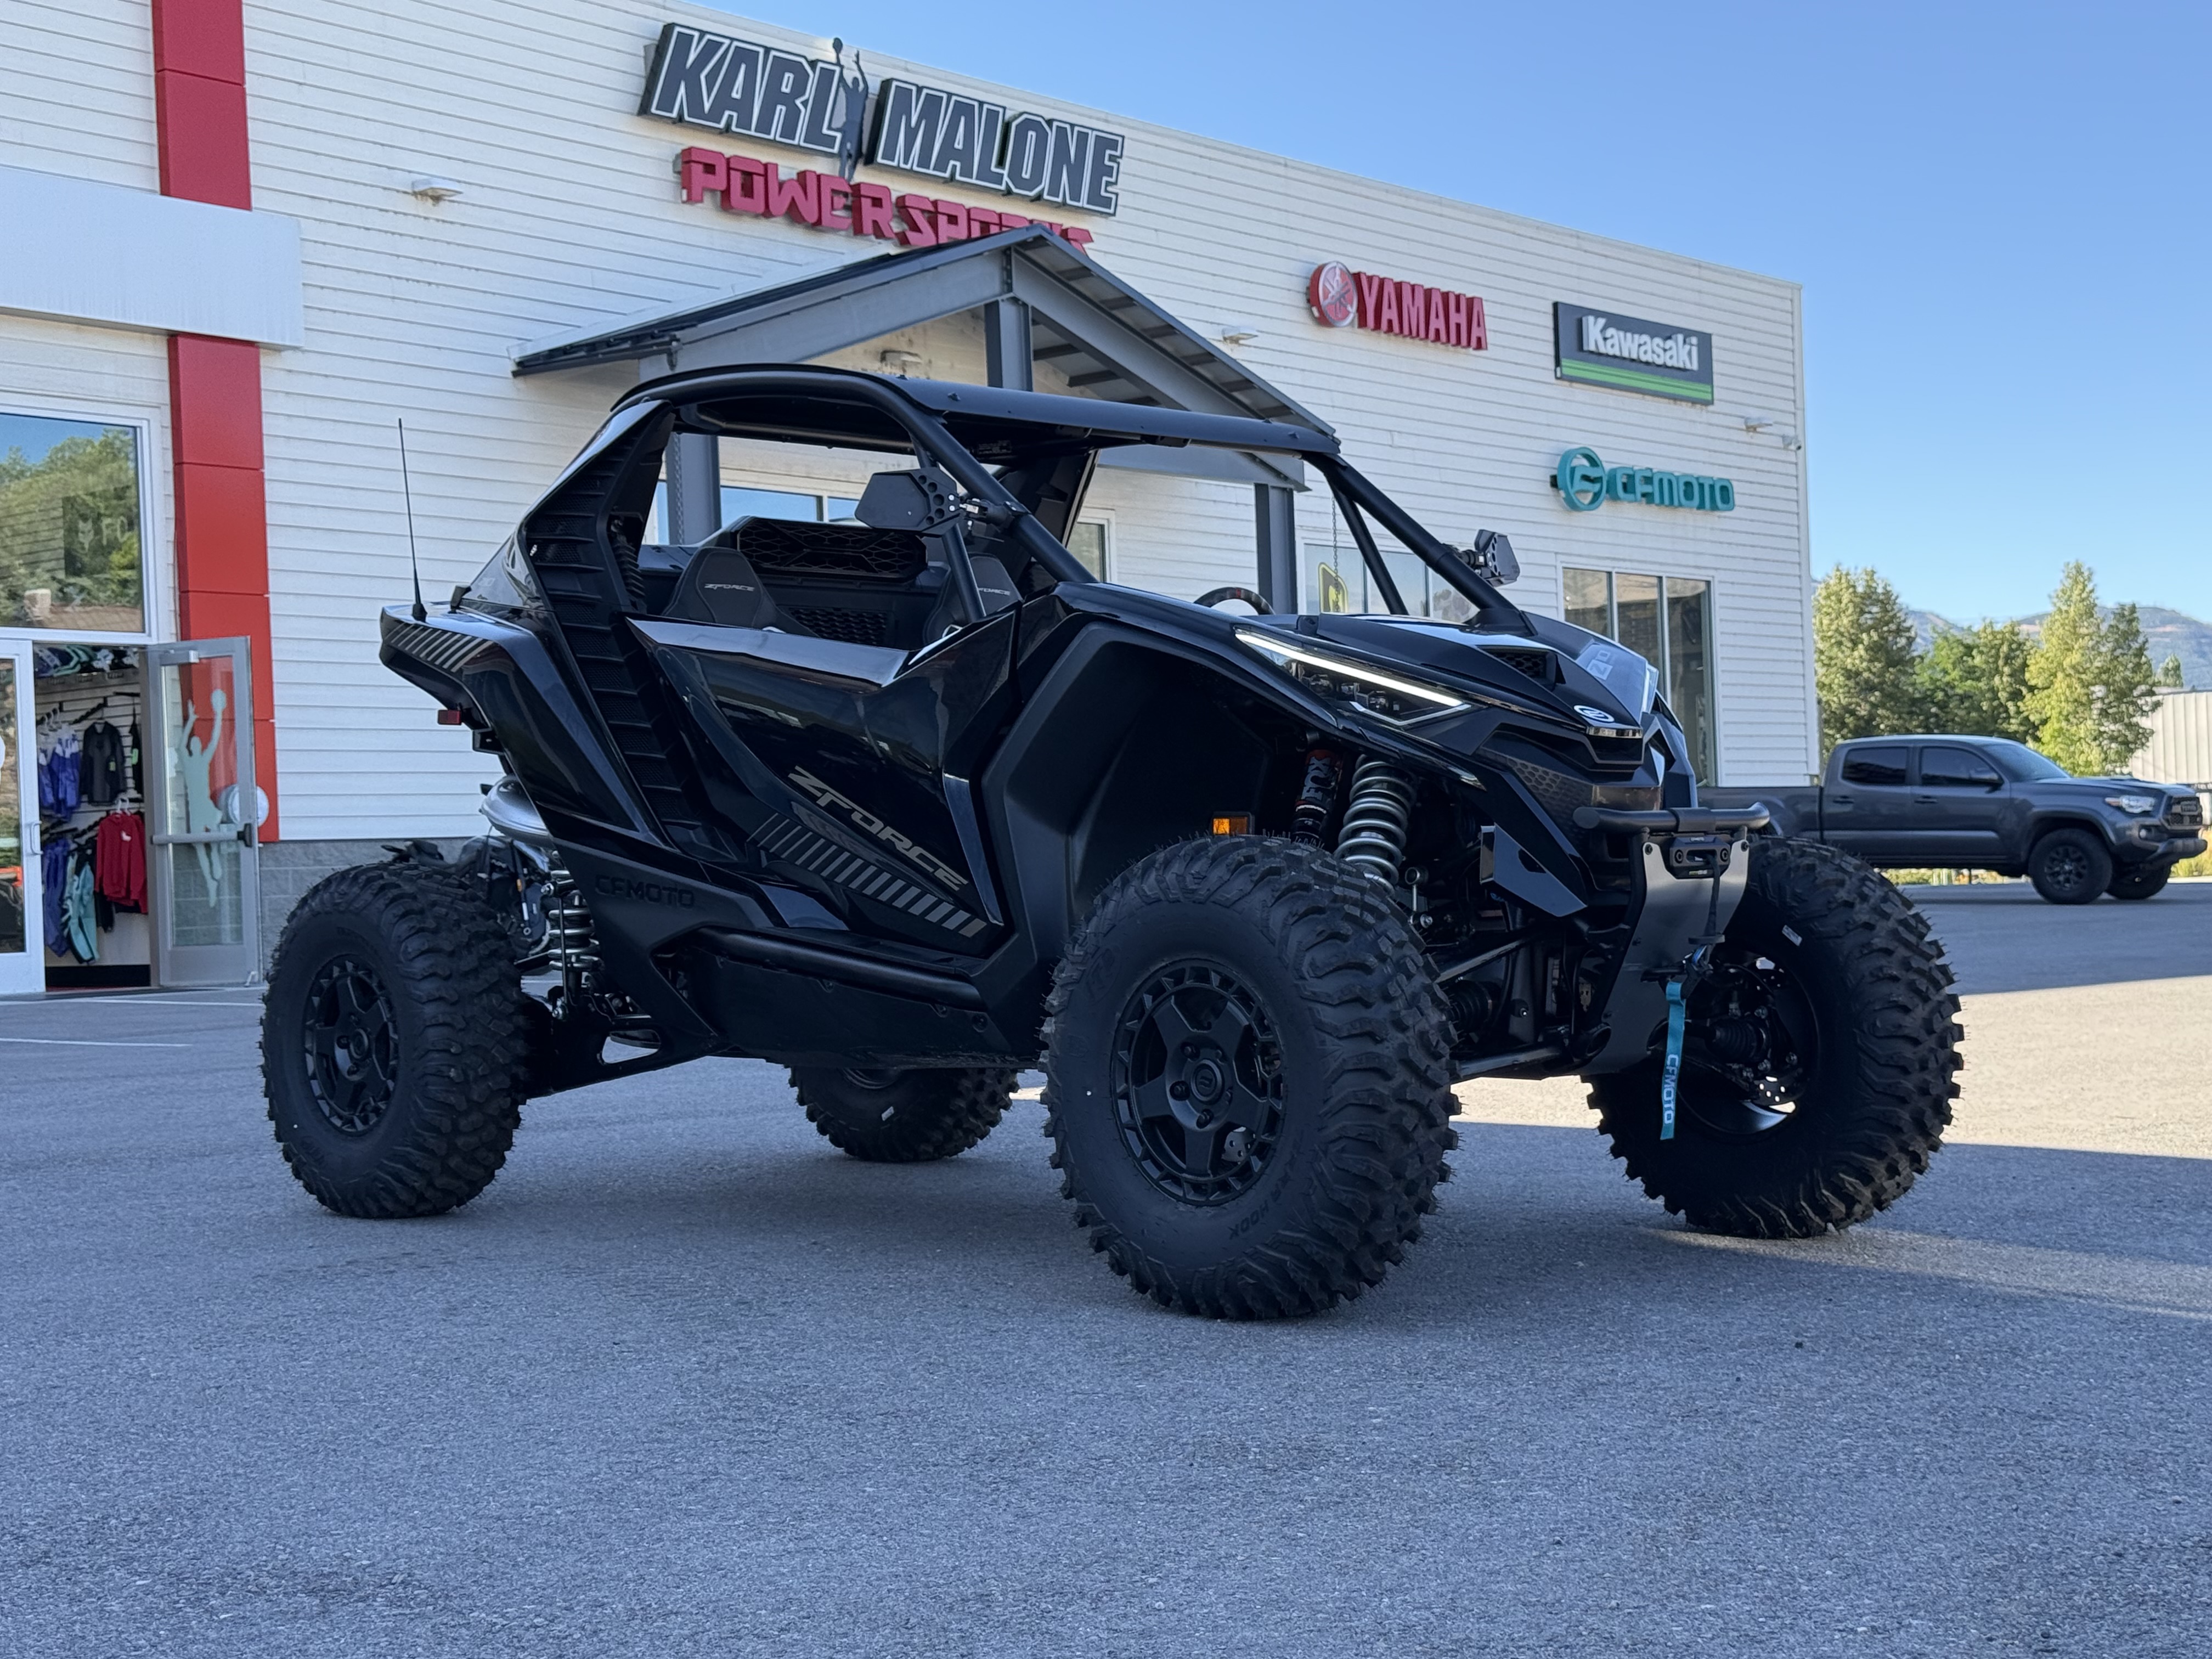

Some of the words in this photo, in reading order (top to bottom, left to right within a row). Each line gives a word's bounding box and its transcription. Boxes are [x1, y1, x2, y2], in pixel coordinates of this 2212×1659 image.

[646, 24, 843, 154] KARL
[870, 78, 1126, 216] MALONE
[681, 146, 1094, 256] POWERSPO
[1352, 272, 1487, 350] YAMAHA
[1580, 314, 1699, 371] Kawasaki
[1606, 466, 1735, 511] CFMOTO
[978, 588, 1010, 596] FORCE
[788, 765, 969, 891] ZFORCE
[595, 874, 695, 909] CFMOTO
[1663, 1053, 1679, 1125] CFMOTO
